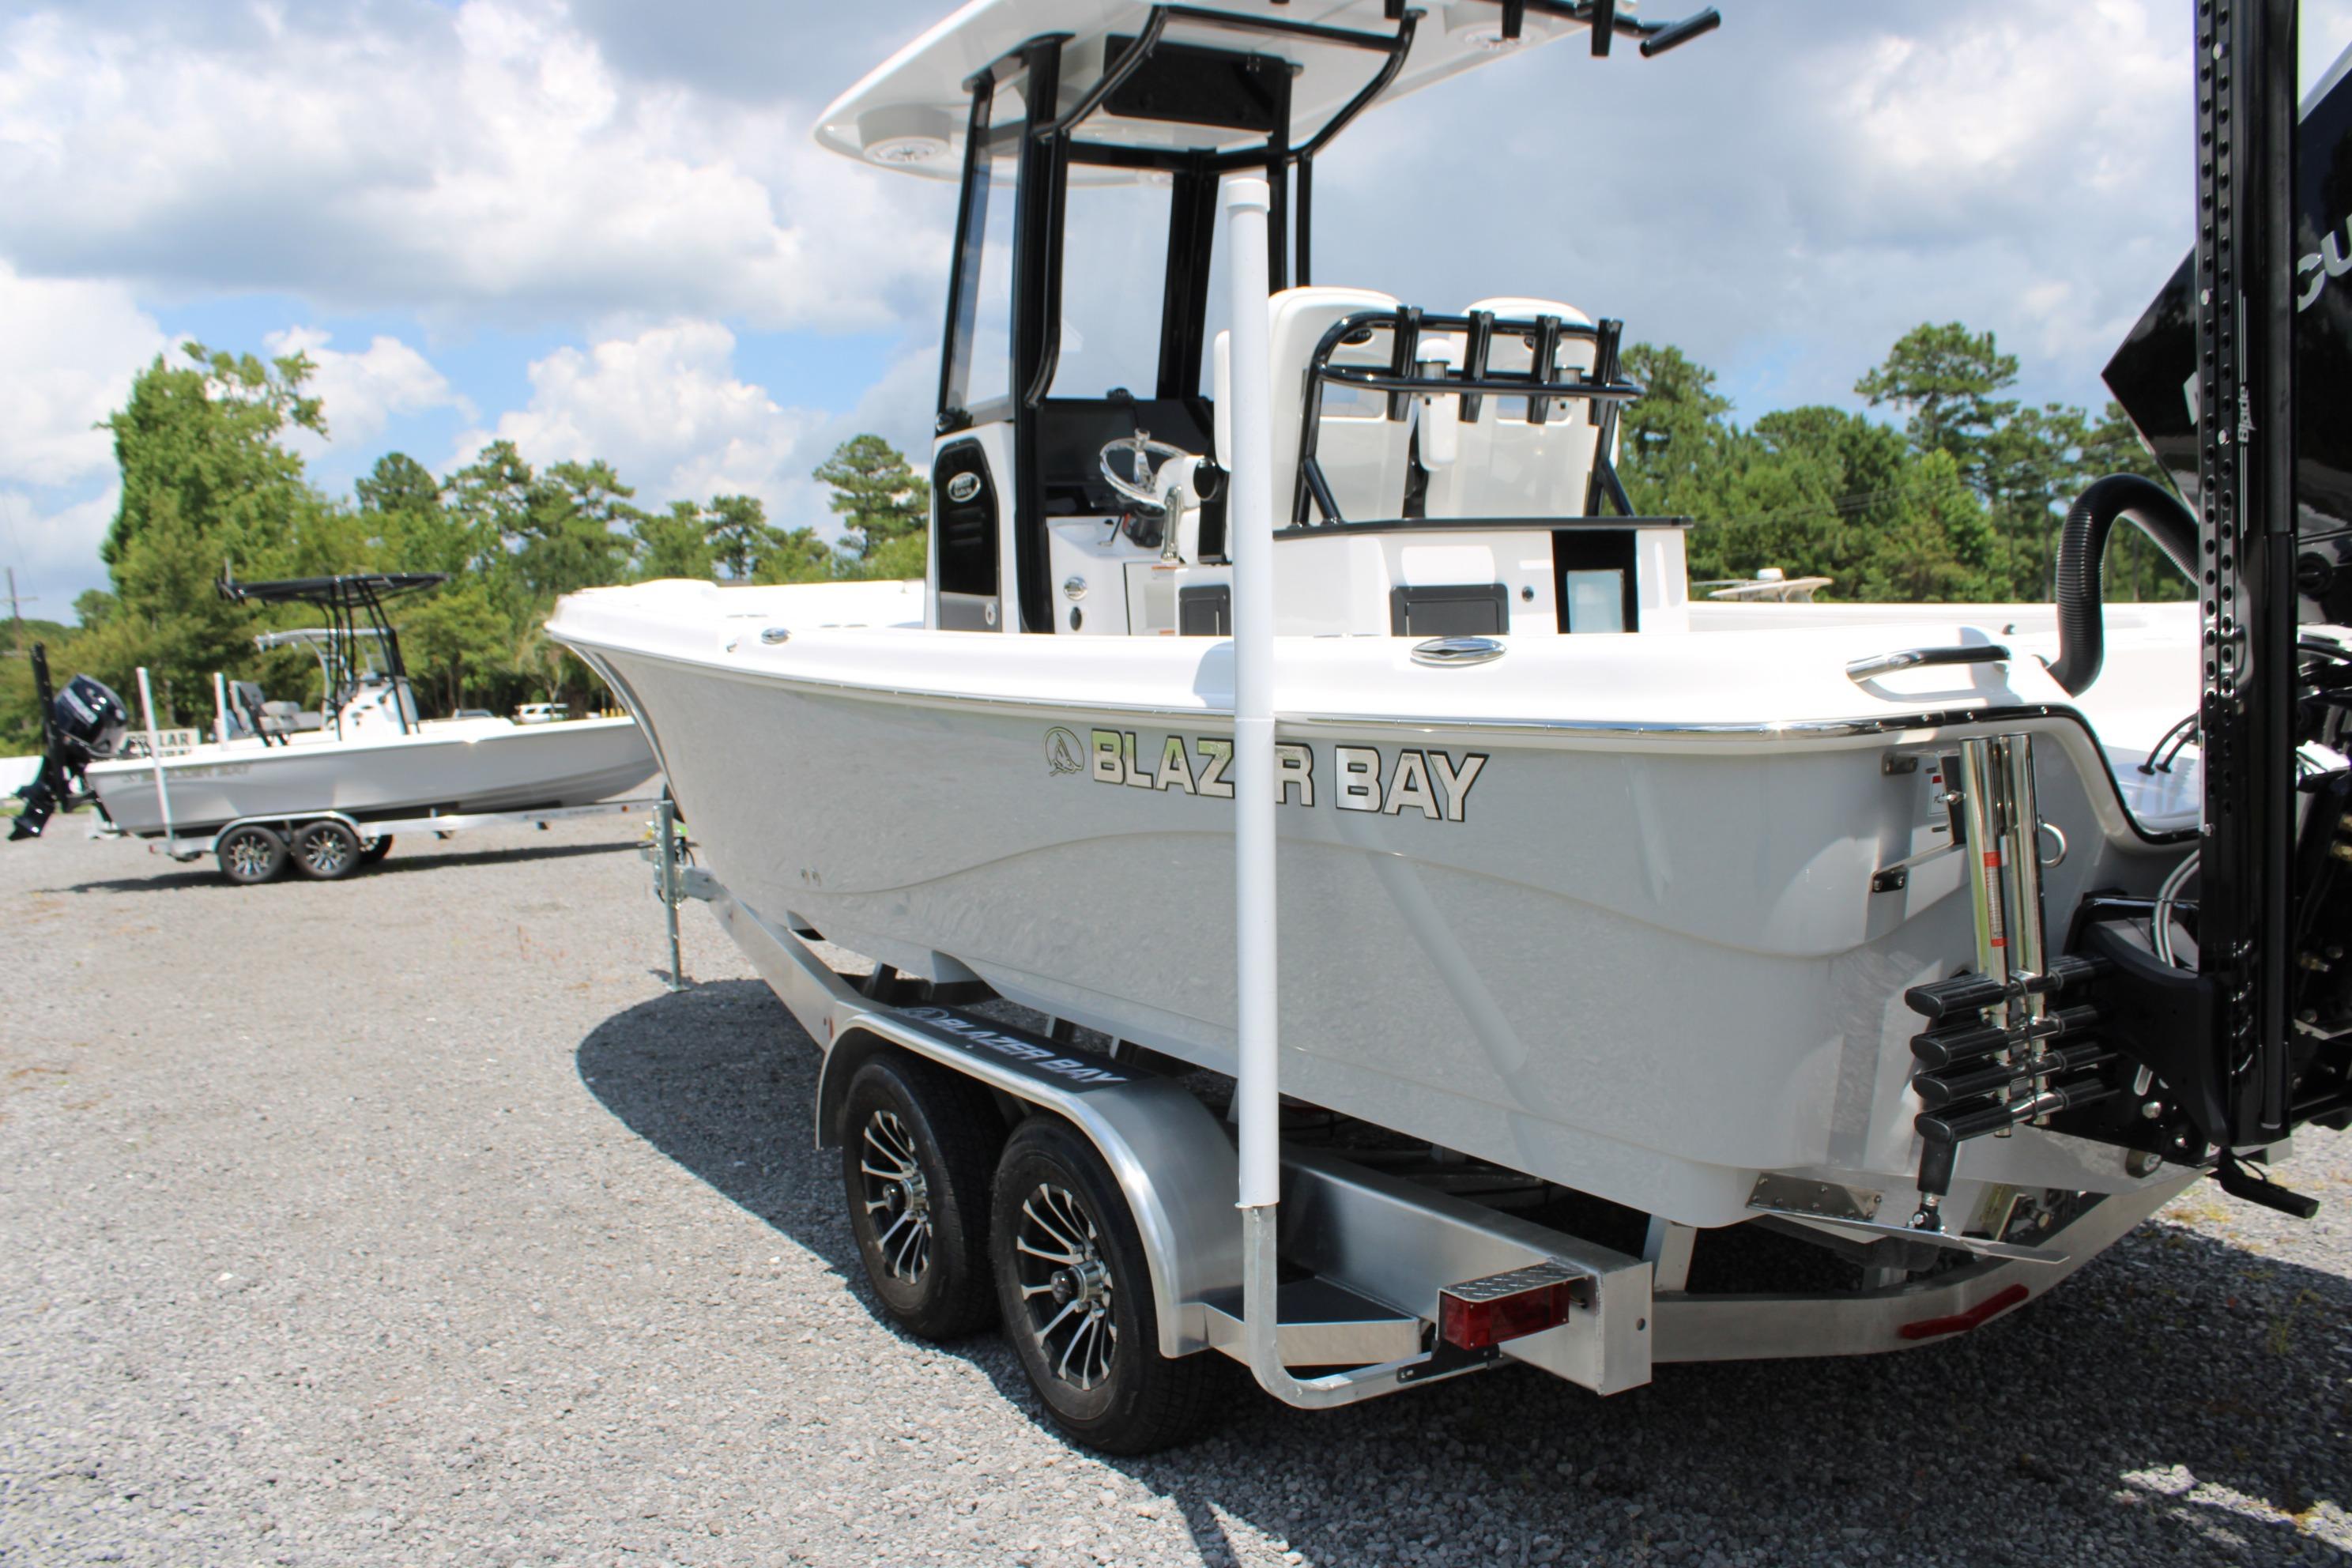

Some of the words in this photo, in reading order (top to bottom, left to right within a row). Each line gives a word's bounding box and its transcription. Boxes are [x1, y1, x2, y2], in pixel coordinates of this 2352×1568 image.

[2237, 385, 2257, 443] Blade
[1091, 728, 1315, 807] BLAZR
[1334, 744, 1490, 822] BAY
[924, 1018, 1057, 1061] BLAZER
[1032, 1058, 1130, 1084] BAY
